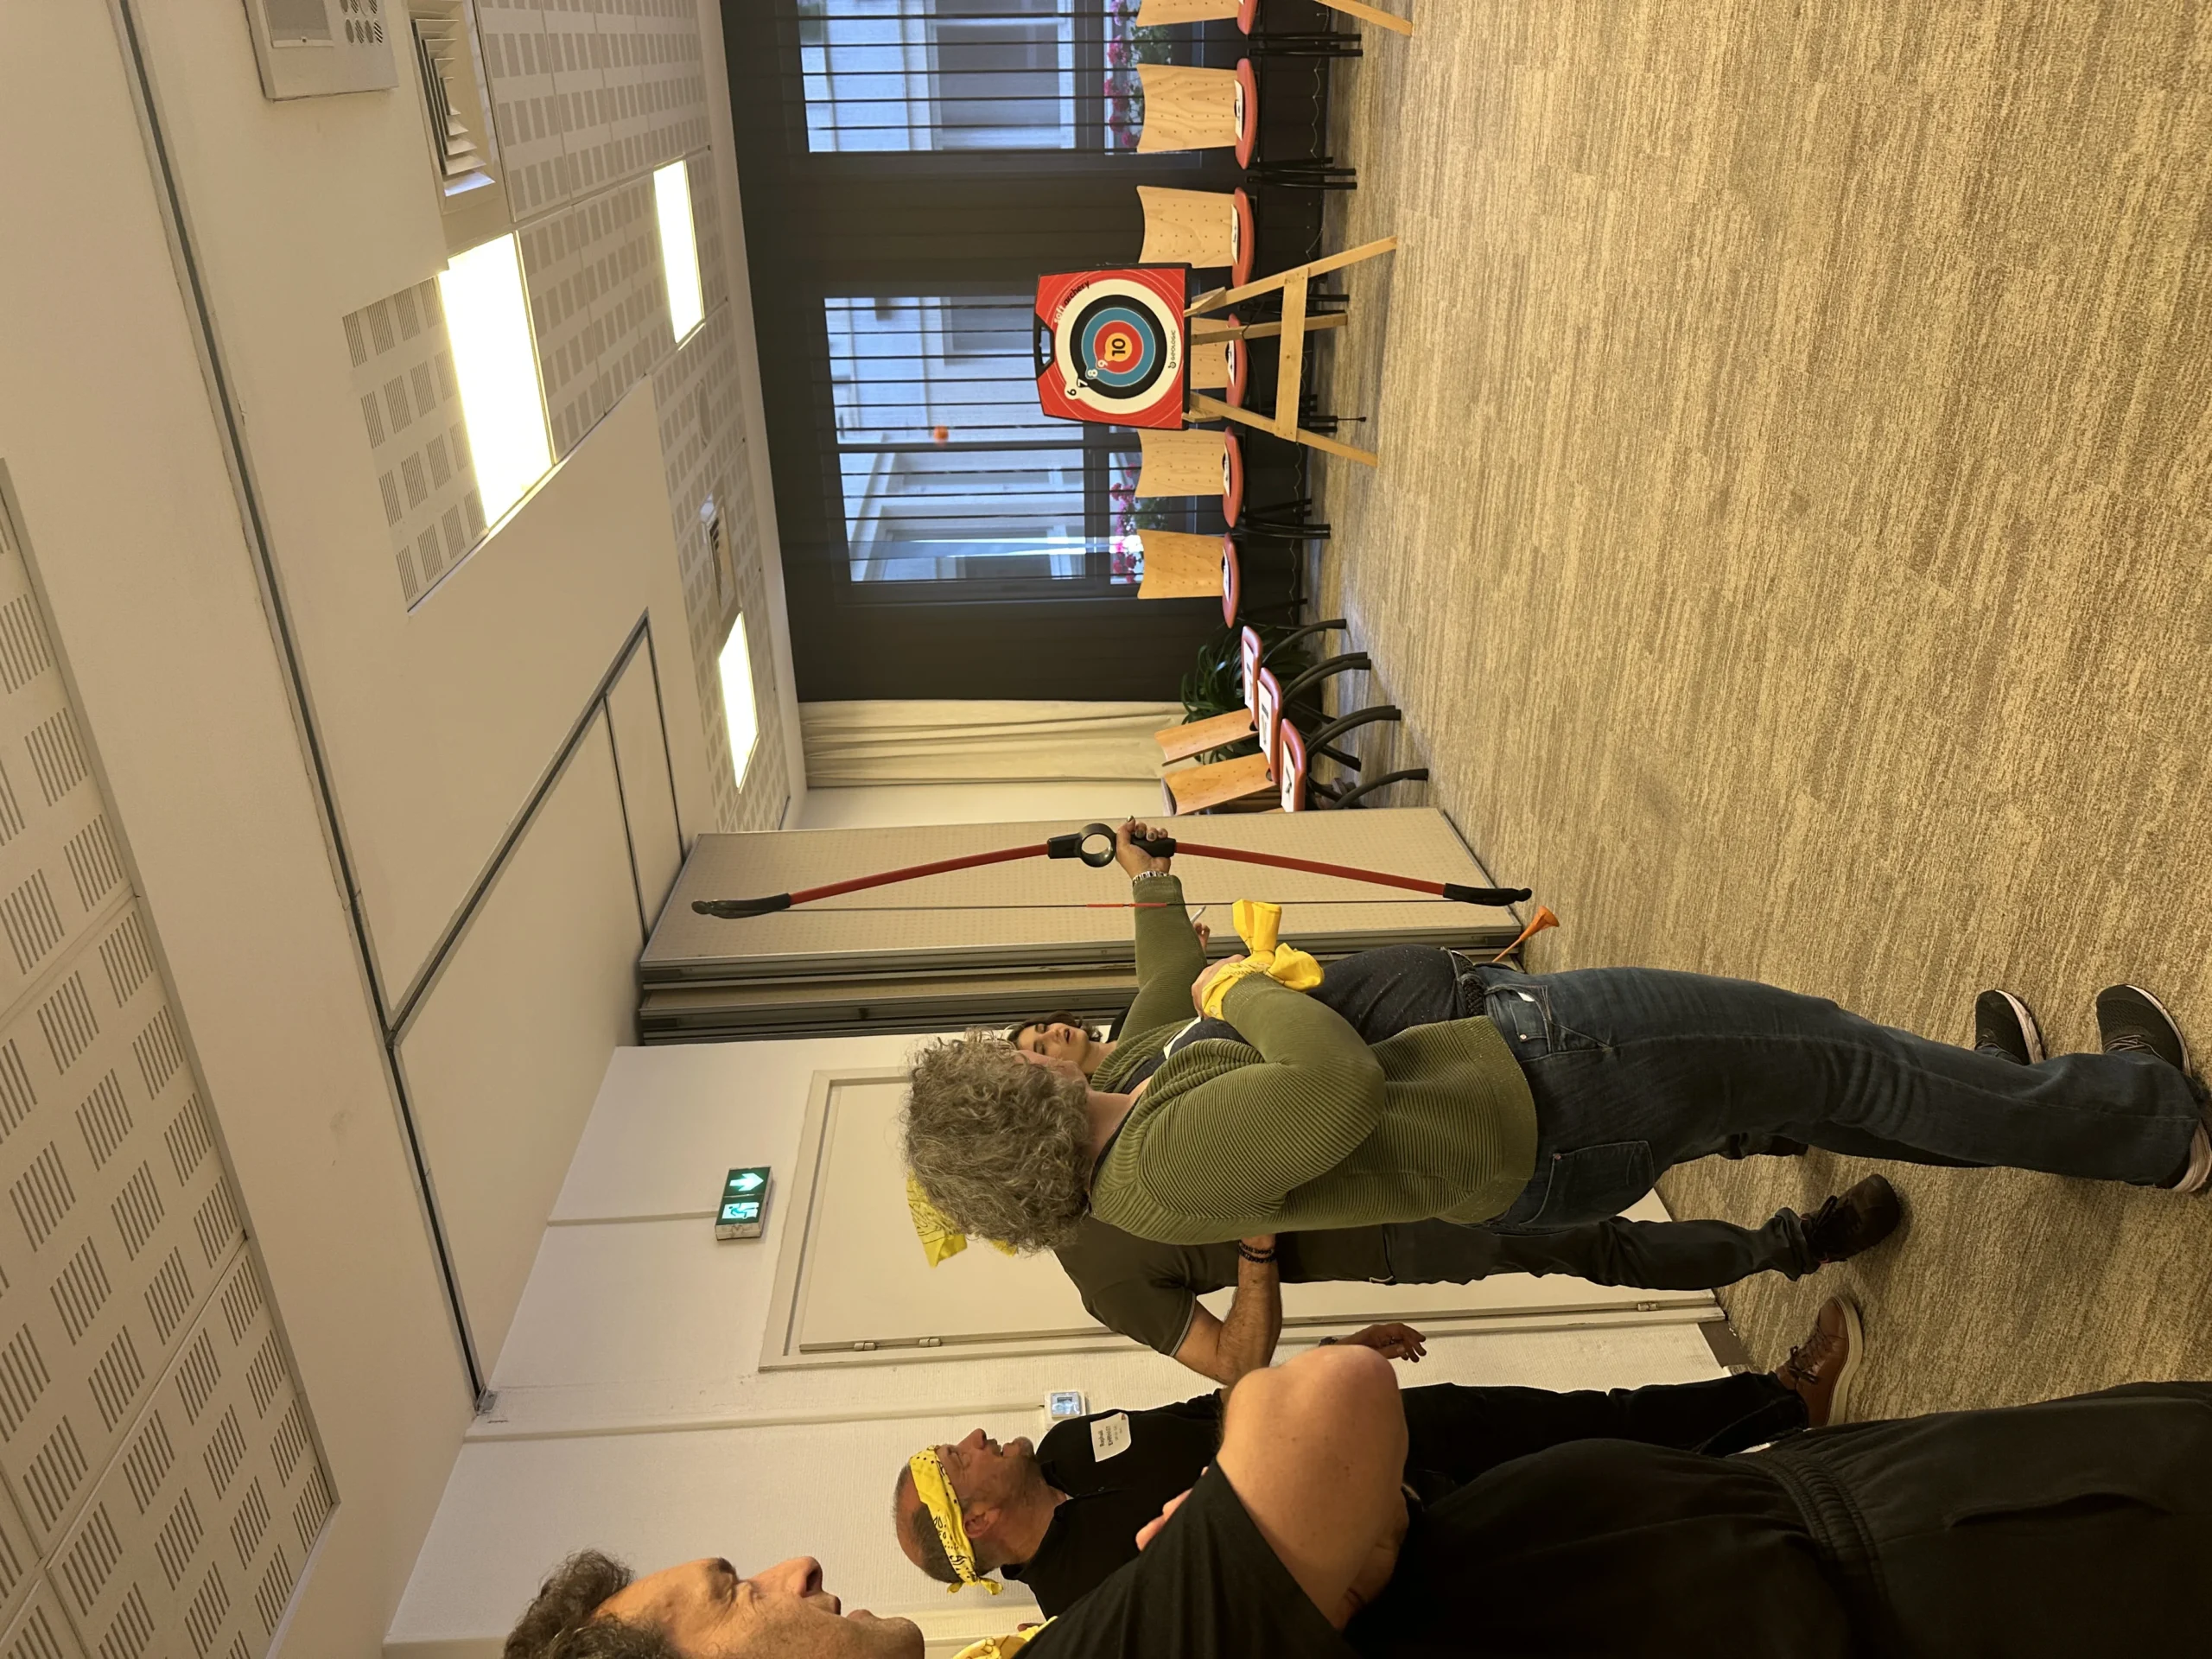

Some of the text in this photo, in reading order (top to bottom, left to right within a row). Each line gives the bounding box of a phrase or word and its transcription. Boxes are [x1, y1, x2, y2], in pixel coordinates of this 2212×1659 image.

[1053, 281, 1090, 324] soft archery
[1111, 338, 1126, 356] 10
[1097, 359, 1109, 368] 9
[1087, 368, 1098, 378] 8
[1077, 378, 1089, 387] 7
[1066, 388, 1077, 397] 6
